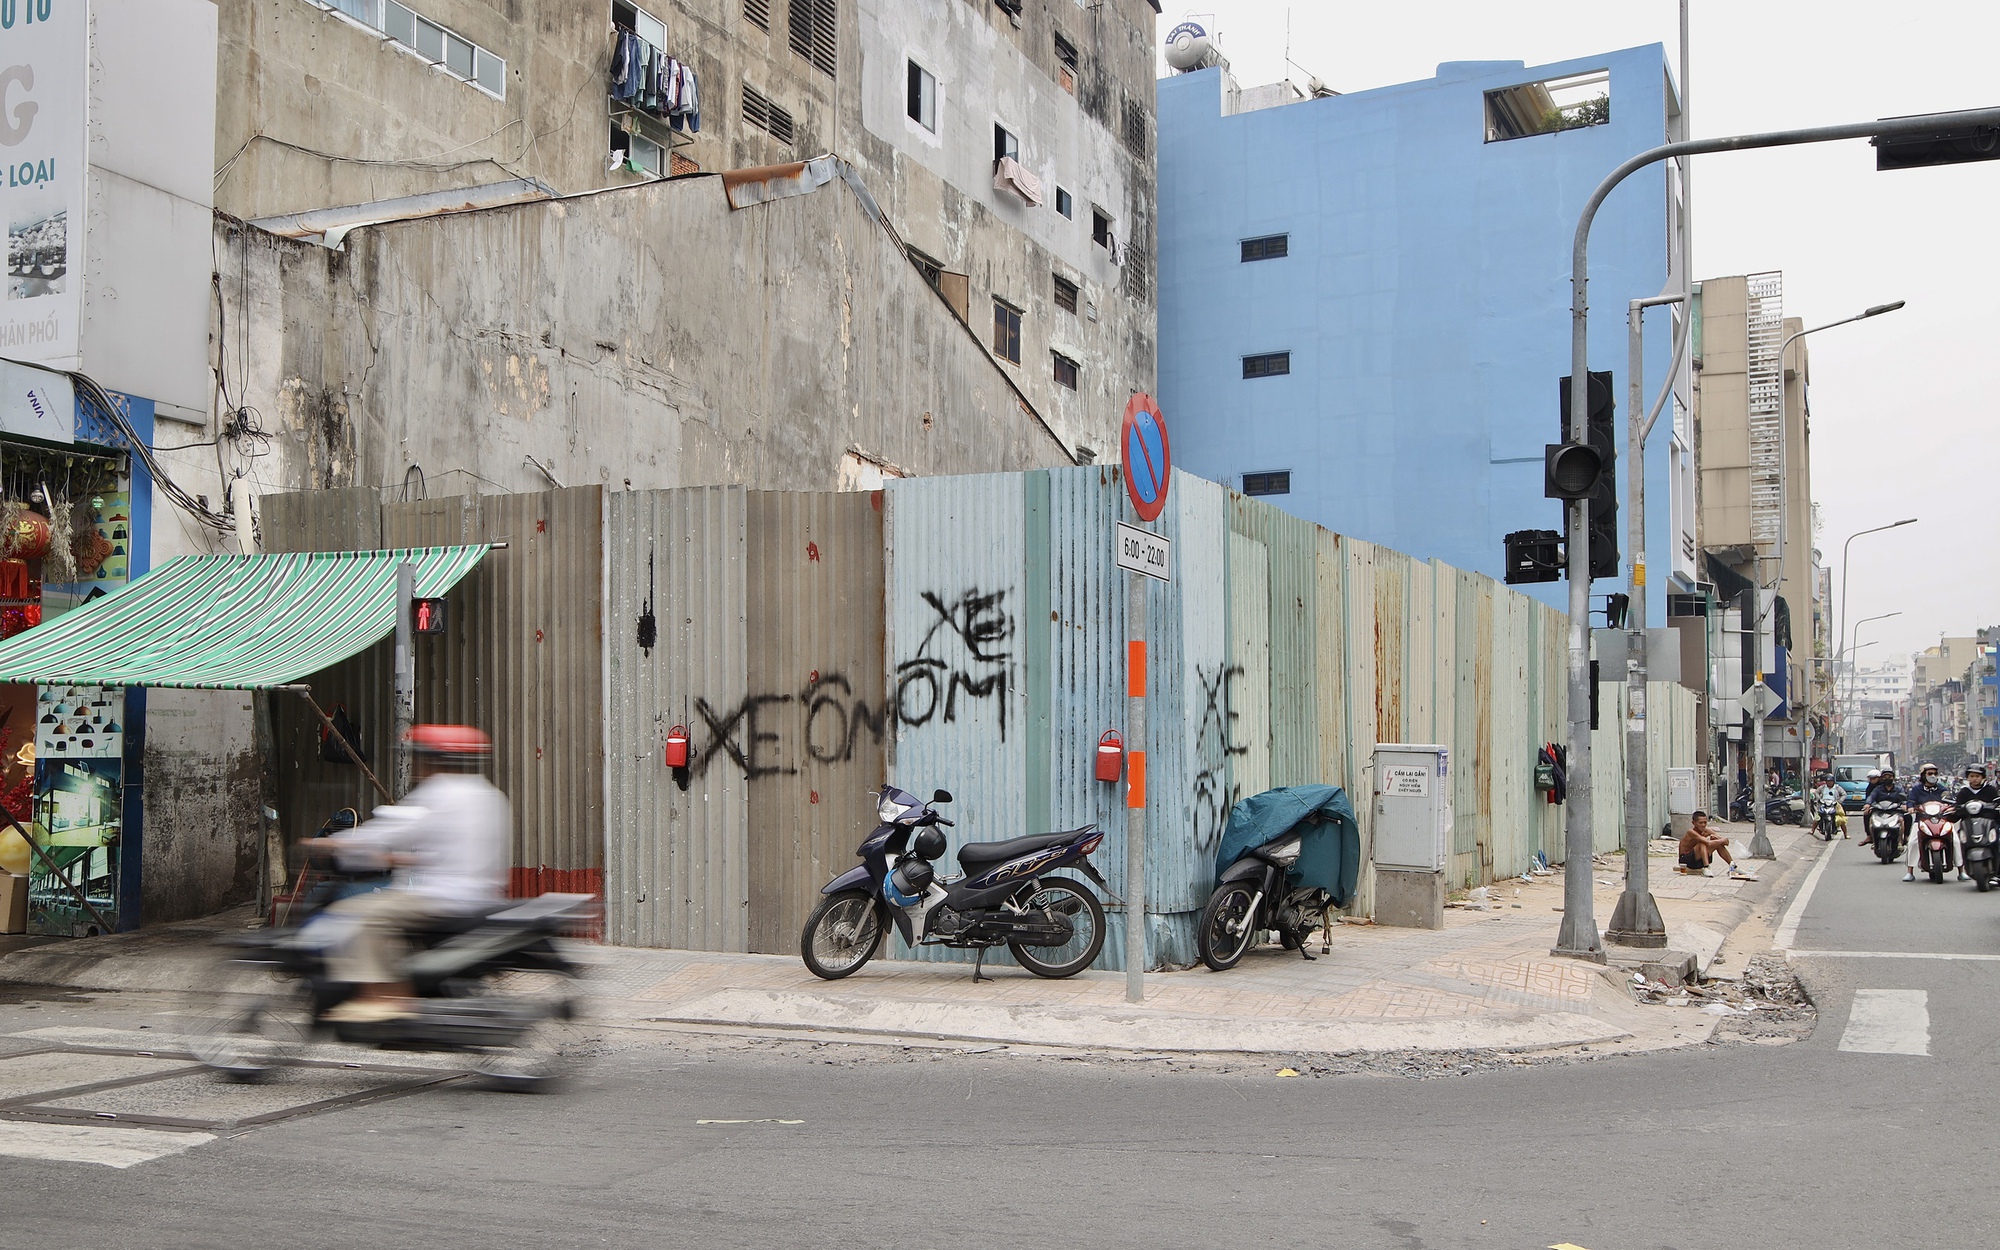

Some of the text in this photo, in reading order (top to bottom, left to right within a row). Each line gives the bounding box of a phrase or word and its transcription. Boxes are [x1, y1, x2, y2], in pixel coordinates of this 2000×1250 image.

[9, 158, 55, 190] LOẠI
[28, 309, 59, 344] PHỐI
[27, 390, 45, 419] VINA
[1124, 537, 1140, 559] 6:00
[1147, 545, 1165, 567] 22:00
[1196, 662, 1247, 757] XE
